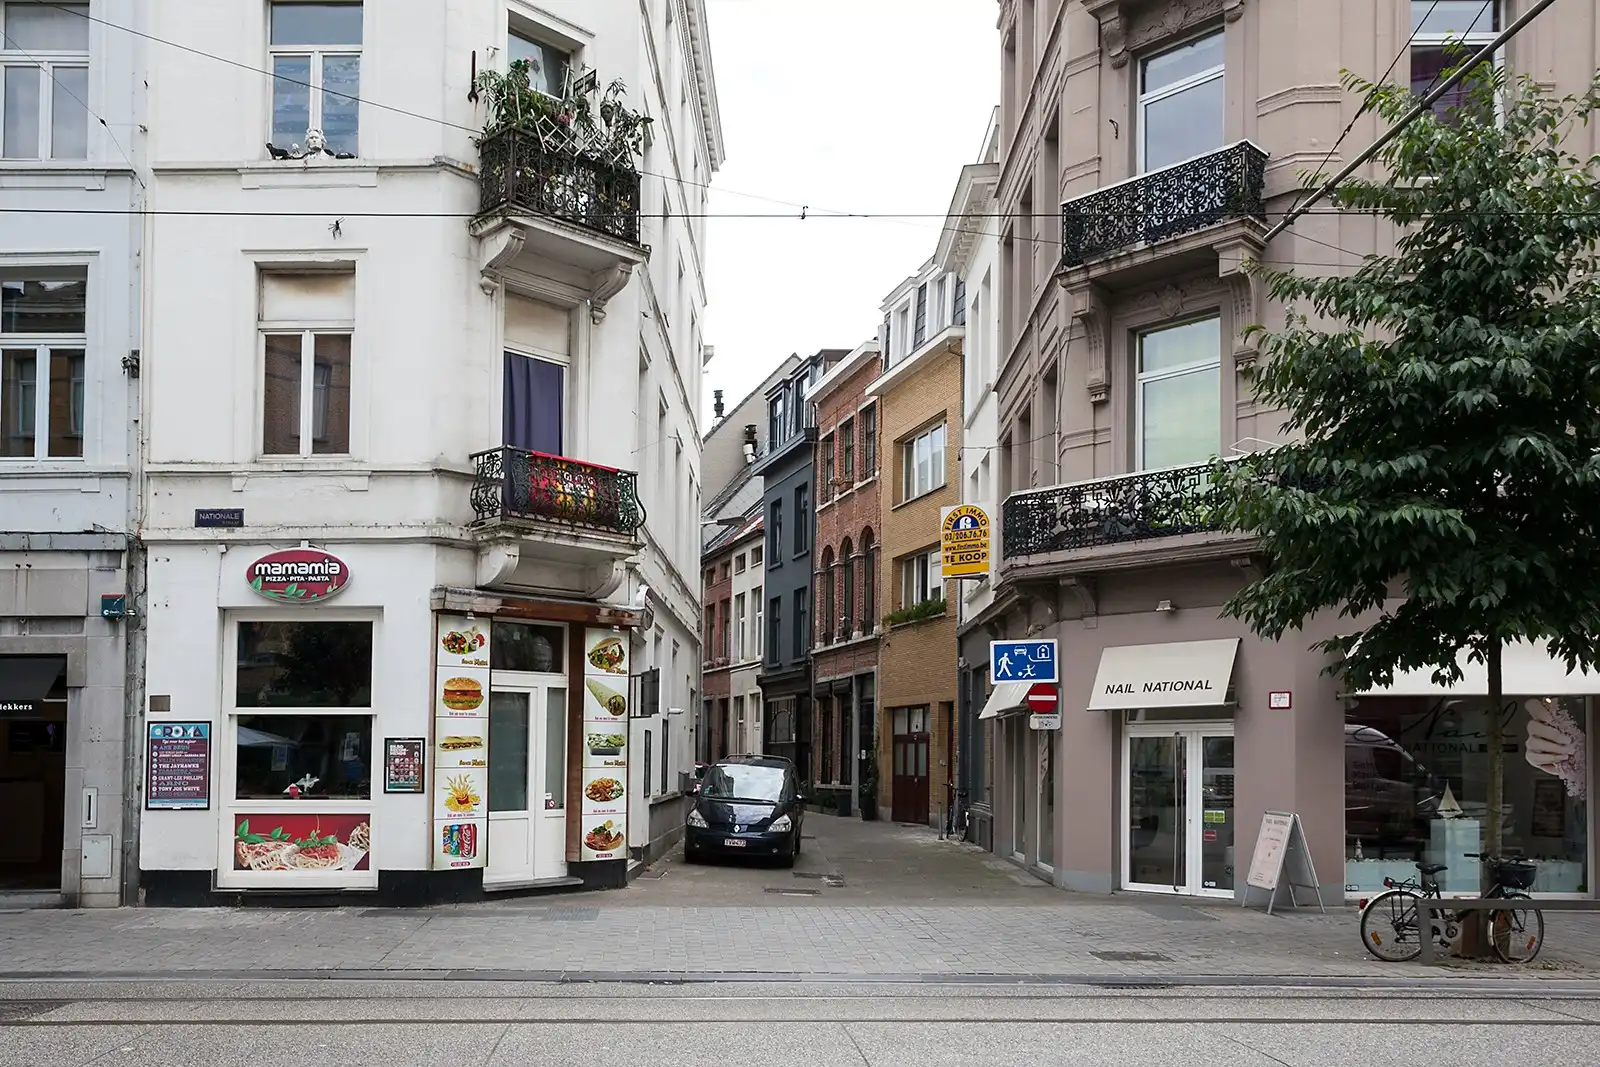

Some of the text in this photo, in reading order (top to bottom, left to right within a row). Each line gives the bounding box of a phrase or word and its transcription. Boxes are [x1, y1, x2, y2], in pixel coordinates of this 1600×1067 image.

[945, 508, 987, 530] FIRST IMMO
[959, 552, 987, 562] KOOP
[255, 558, 340, 575] mamamia
[1105, 680, 1213, 694] NAIL NATIONAL
[162, 726, 203, 737] ROMA
